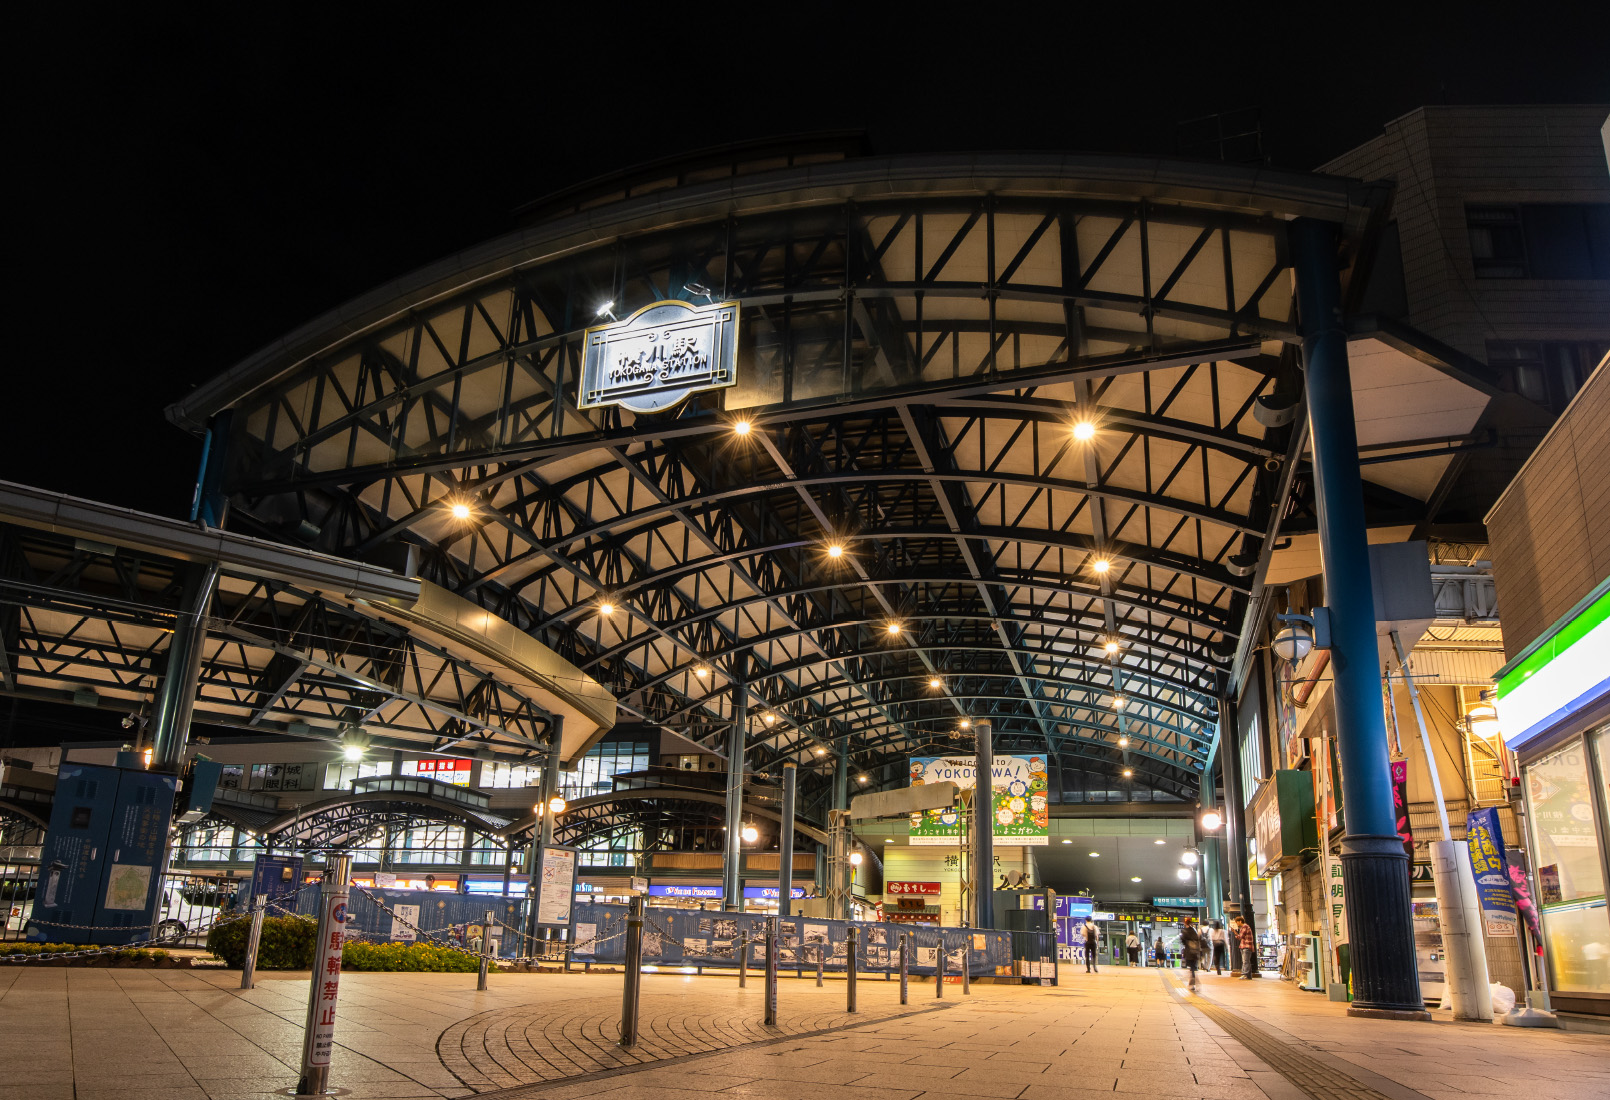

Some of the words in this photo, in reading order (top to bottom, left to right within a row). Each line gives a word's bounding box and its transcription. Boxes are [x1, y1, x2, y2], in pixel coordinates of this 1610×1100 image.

[609, 363, 658, 379] YOKOGAWA
[662, 353, 708, 370] STATION
[996, 758, 1006, 766] to
[934, 765, 1021, 780] YOKOWA!
[265, 779, 299, 789] 眼科
[903, 883, 927, 894] むさし
[319, 931, 345, 1026] 駐輪禁止
